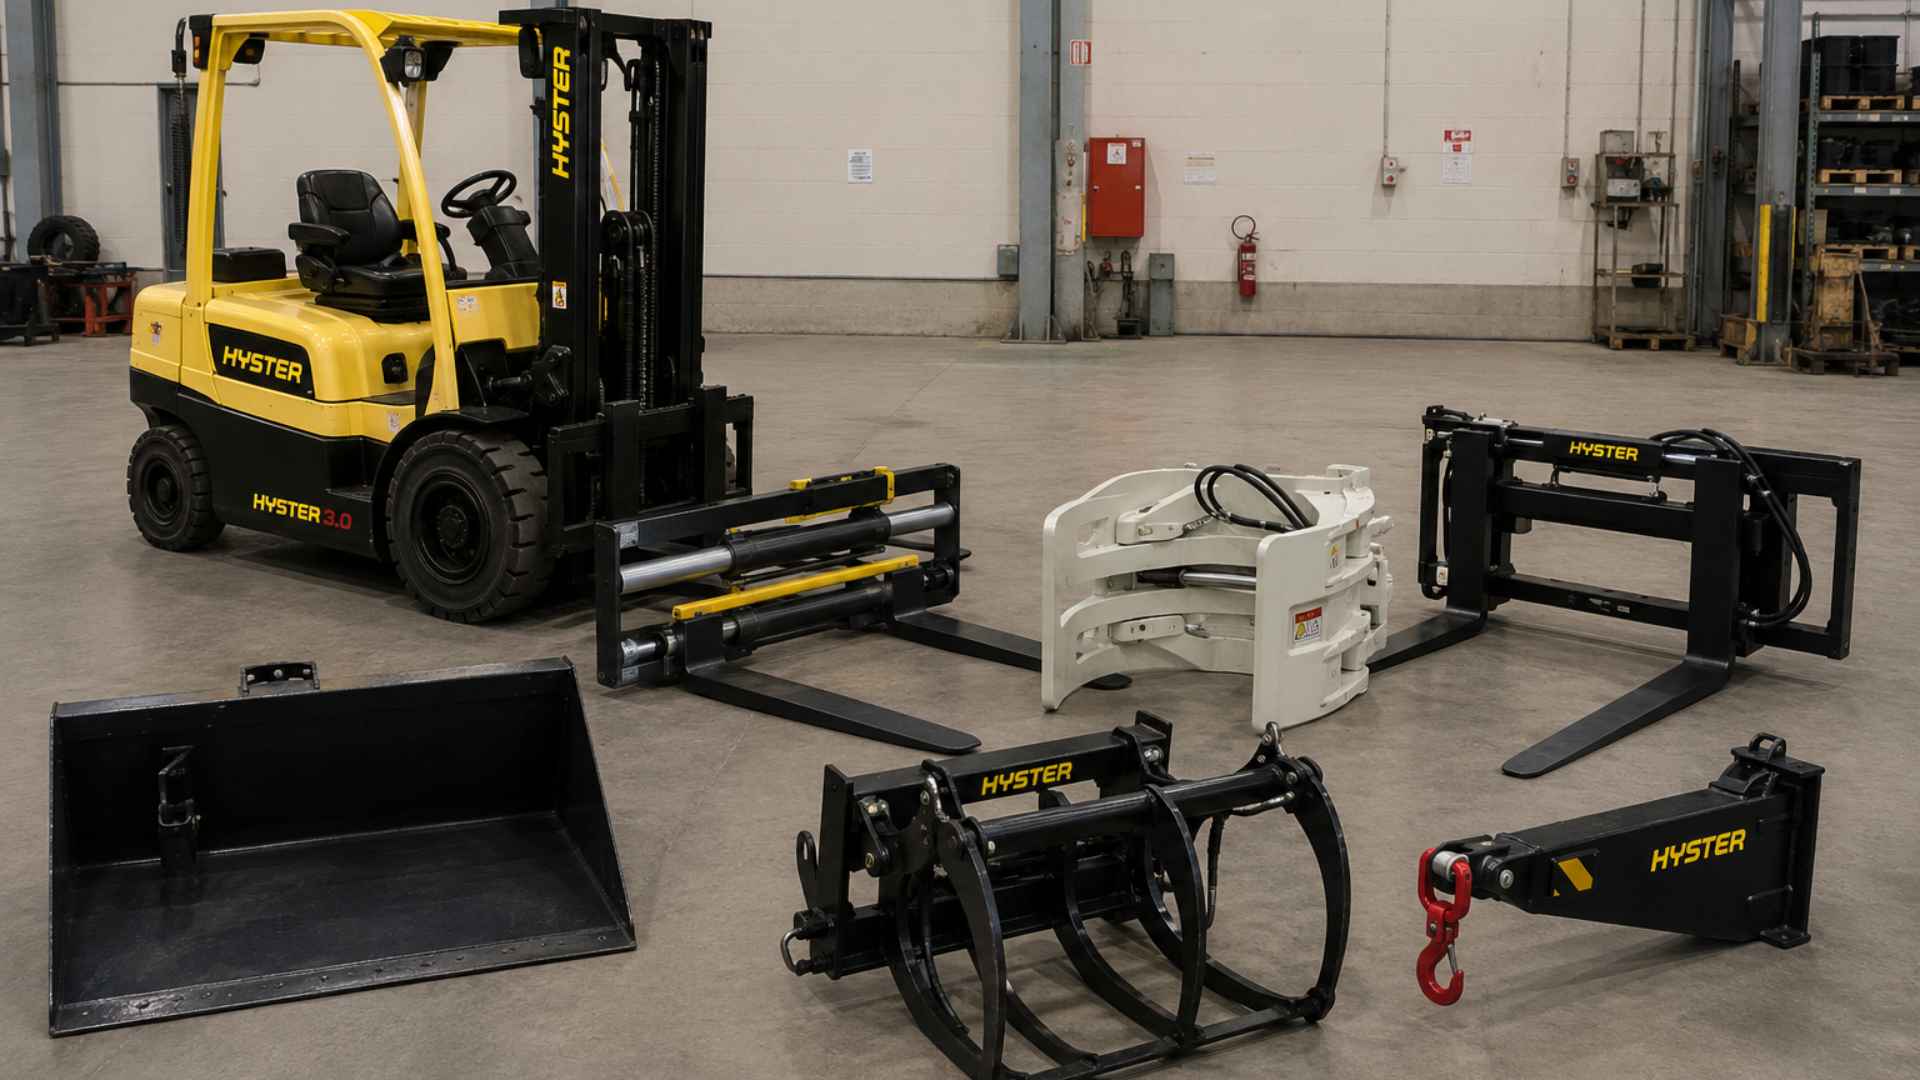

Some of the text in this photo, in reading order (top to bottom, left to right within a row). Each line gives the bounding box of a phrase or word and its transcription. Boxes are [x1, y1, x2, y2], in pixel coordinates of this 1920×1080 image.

[551, 46, 571, 179] HYSTER
[222, 345, 303, 384] HYSTER
[1569, 441, 1639, 462] HYSTER
[252, 493, 353, 530] HYSTER 3.0
[981, 761, 1073, 796] HYSTER
[1650, 828, 1746, 873] HYSTER
